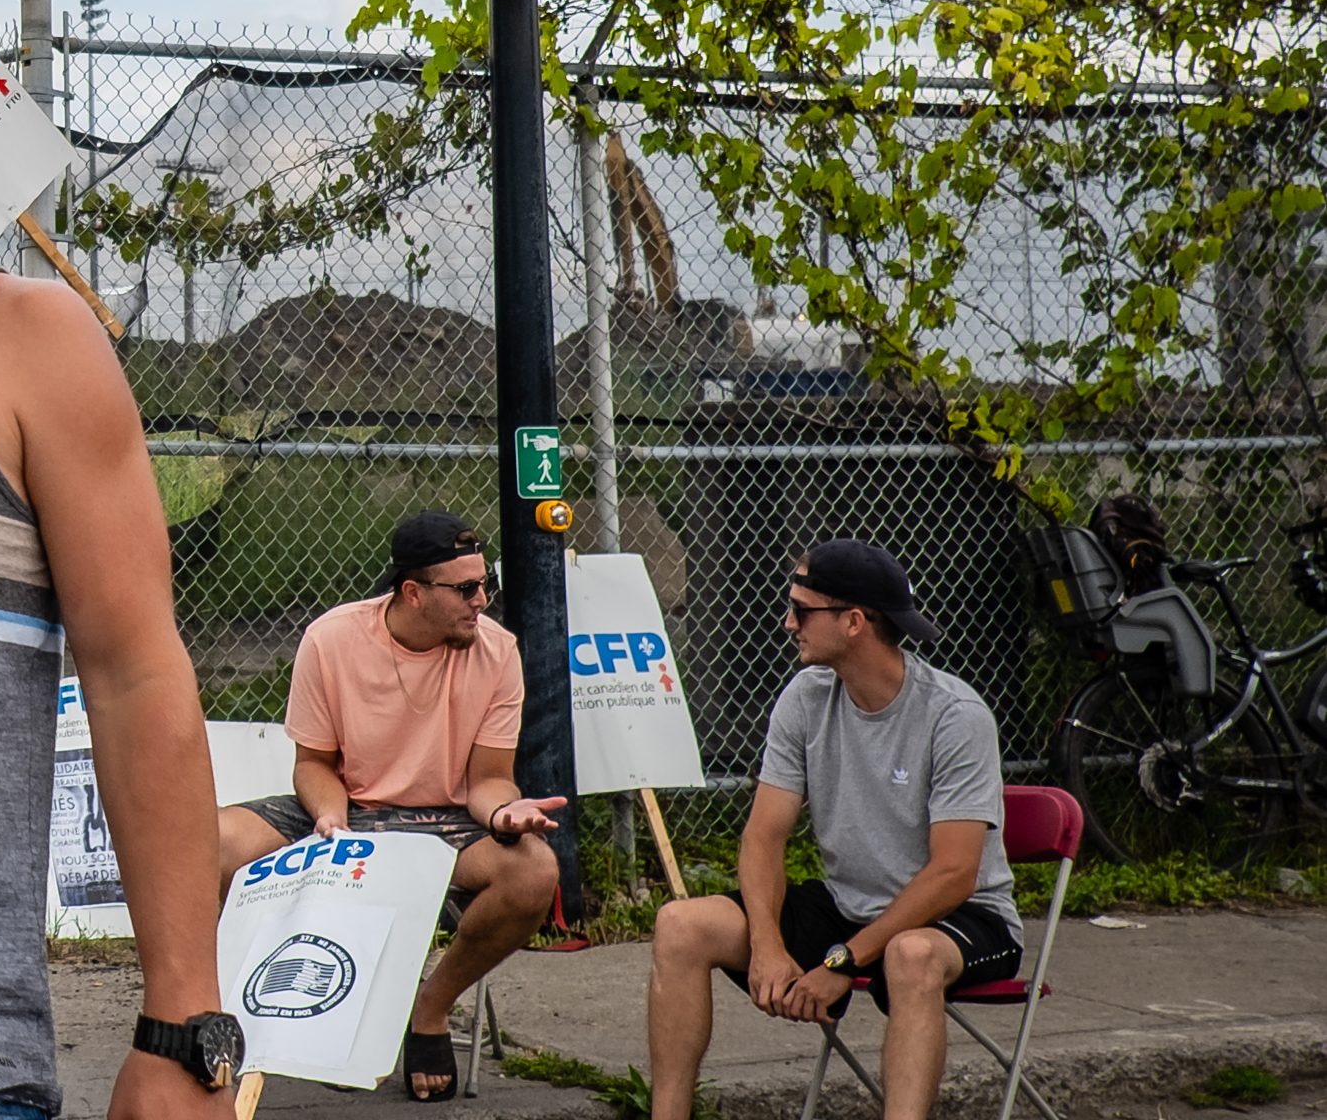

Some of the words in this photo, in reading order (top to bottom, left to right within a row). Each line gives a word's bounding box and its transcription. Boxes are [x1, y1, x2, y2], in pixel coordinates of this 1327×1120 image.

[569, 632, 666, 676] CFP
[587, 682, 639, 695] canadien
[641, 681, 655, 692] de
[573, 698, 604, 711] ction
[606, 696, 655, 710] publique
[58, 719, 82, 728] adien
[57, 728, 89, 739] ubliqu
[53, 794, 75, 811] IÉS
[57, 856, 88, 866] NOUS
[91, 853, 116, 864] SOM
[244, 838, 375, 886] SCFP
[59, 869, 119, 883] DÉBARDE
[239, 882, 278, 899] Syndicat
[327, 867, 343, 879] de
[247, 888, 289, 905] fonction
